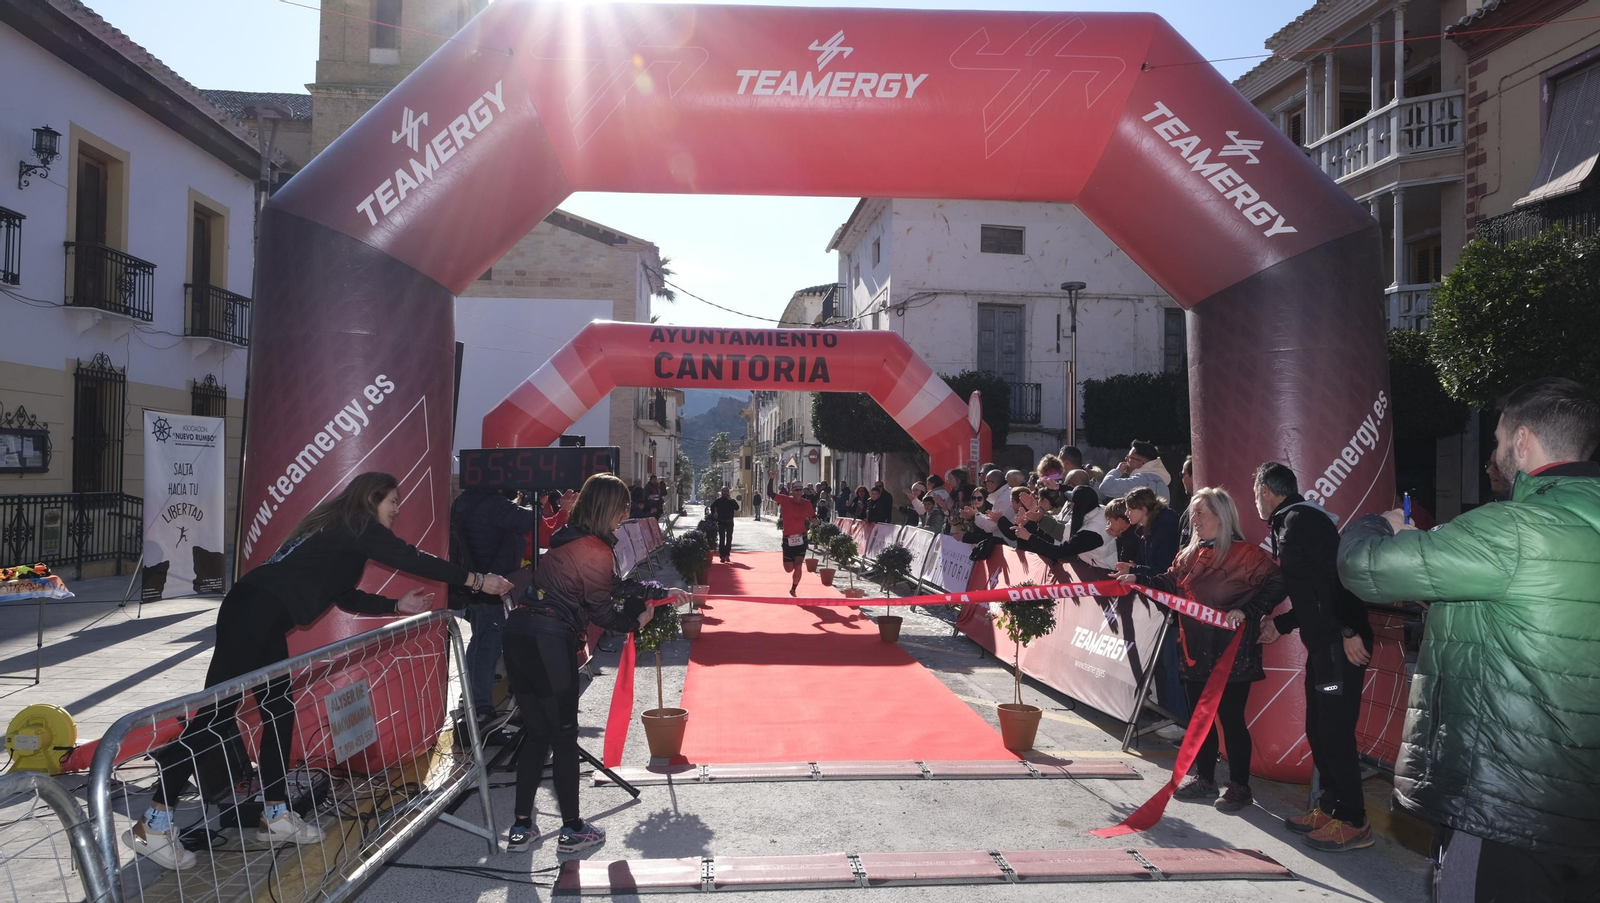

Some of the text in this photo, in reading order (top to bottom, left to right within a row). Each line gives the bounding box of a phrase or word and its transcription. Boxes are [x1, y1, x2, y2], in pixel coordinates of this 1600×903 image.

[736, 69, 929, 101] TEAMERGY
[356, 80, 505, 226] TEAMERGY
[1142, 101, 1298, 237] TEAMERGY
[649, 327, 838, 348] AYUNTAMIENTO
[654, 351, 831, 383] CANTORIA
[174, 462, 193, 476] SALTA
[243, 374, 395, 560] www.teamergy.es
[168, 482, 199, 496] HACIA TU
[161, 502, 204, 524] LIBERTAD
[1008, 583, 1102, 602] POLVORA
[1070, 625, 1135, 662] TEAMERGY
[331, 684, 366, 713] ALYSER DE
